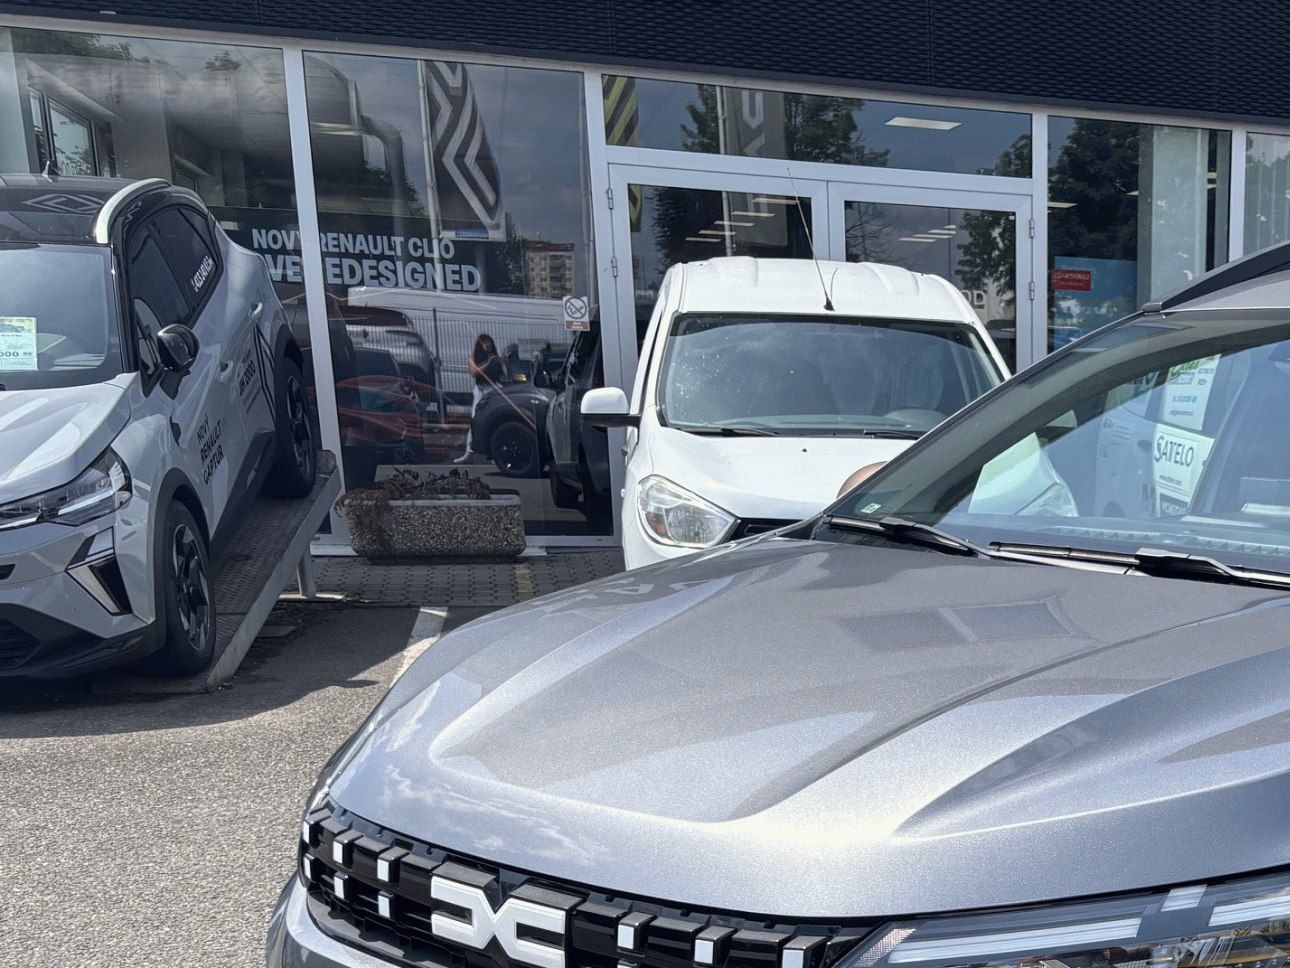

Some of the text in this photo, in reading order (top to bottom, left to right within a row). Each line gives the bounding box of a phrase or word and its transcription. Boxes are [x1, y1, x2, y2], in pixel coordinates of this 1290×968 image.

[252, 228, 301, 250] NOV
[408, 236, 455, 259] CLIO
[325, 257, 482, 293] EDESIGNED
